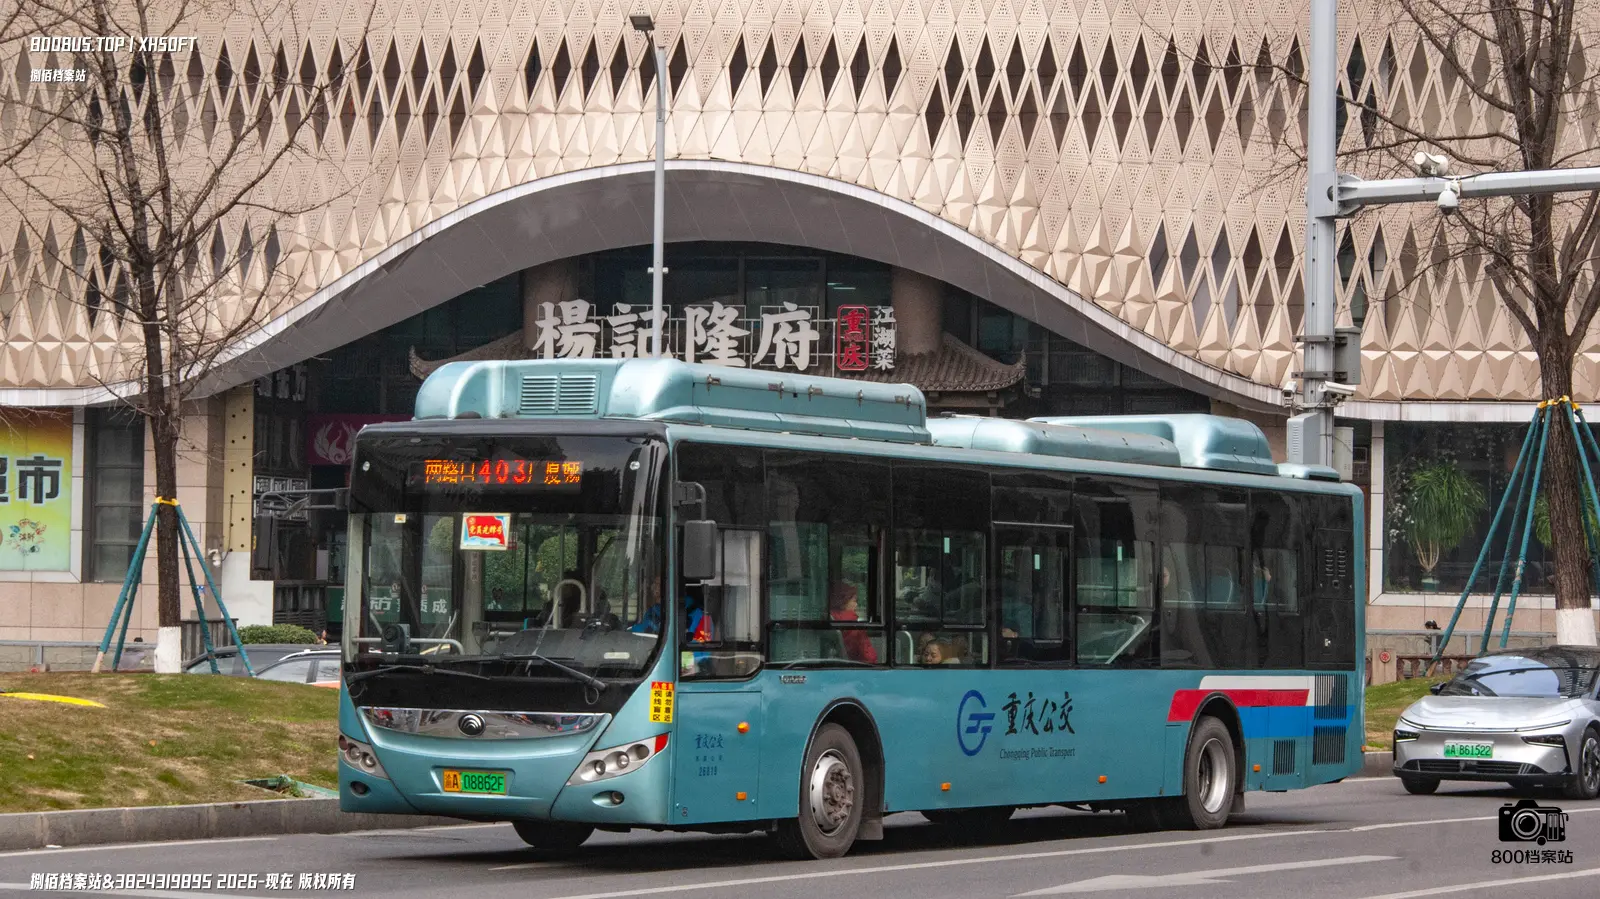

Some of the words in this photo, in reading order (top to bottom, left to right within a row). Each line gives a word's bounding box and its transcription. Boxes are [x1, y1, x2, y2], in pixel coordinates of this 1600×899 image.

[532, 298, 820, 371] 楊記隆府
[841, 308, 865, 367] 重庆
[873, 305, 896, 371] 江湖菜
[478, 459, 526, 484] 403
[1001, 691, 1076, 736] 重庆公交
[999, 748, 1030, 760] Chongqing
[1031, 748, 1048, 758] Public
[1049, 747, 1076, 759] Transport
